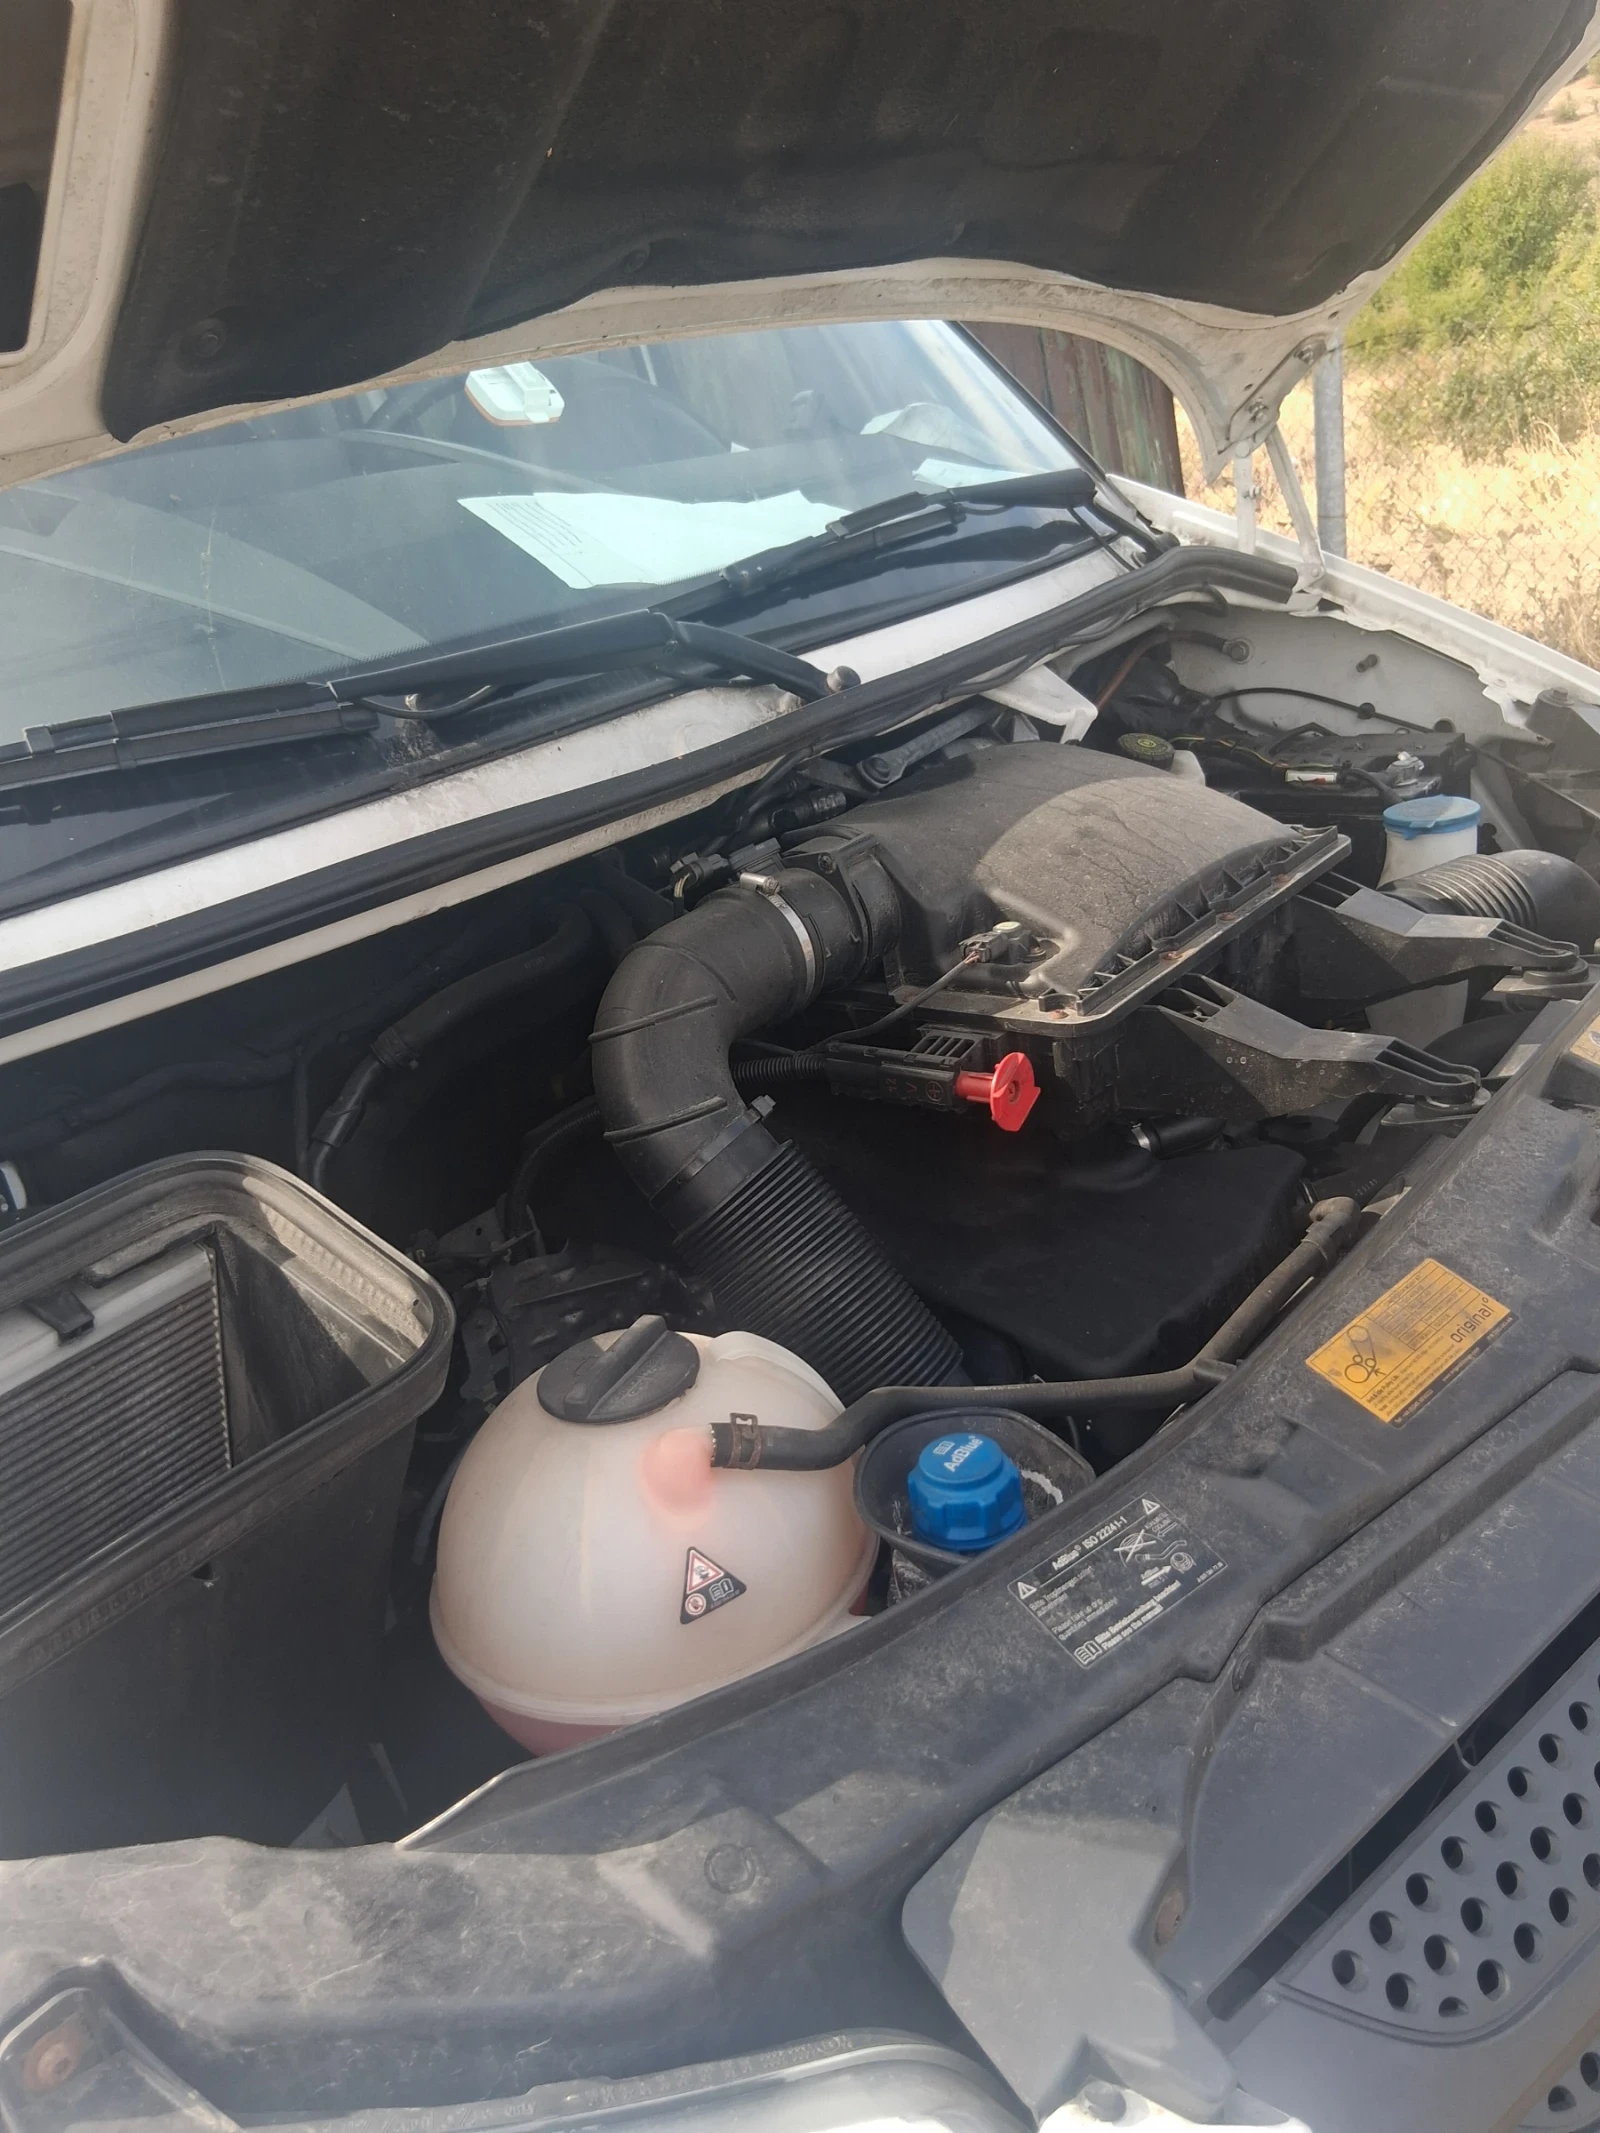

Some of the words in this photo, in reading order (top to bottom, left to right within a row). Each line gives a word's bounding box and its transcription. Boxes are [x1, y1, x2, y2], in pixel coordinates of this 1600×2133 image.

[1082, 1534, 1099, 1549] ISO
[1096, 1515, 1128, 1541] 22241-1
[1100, 1632, 1124, 1651] Please
